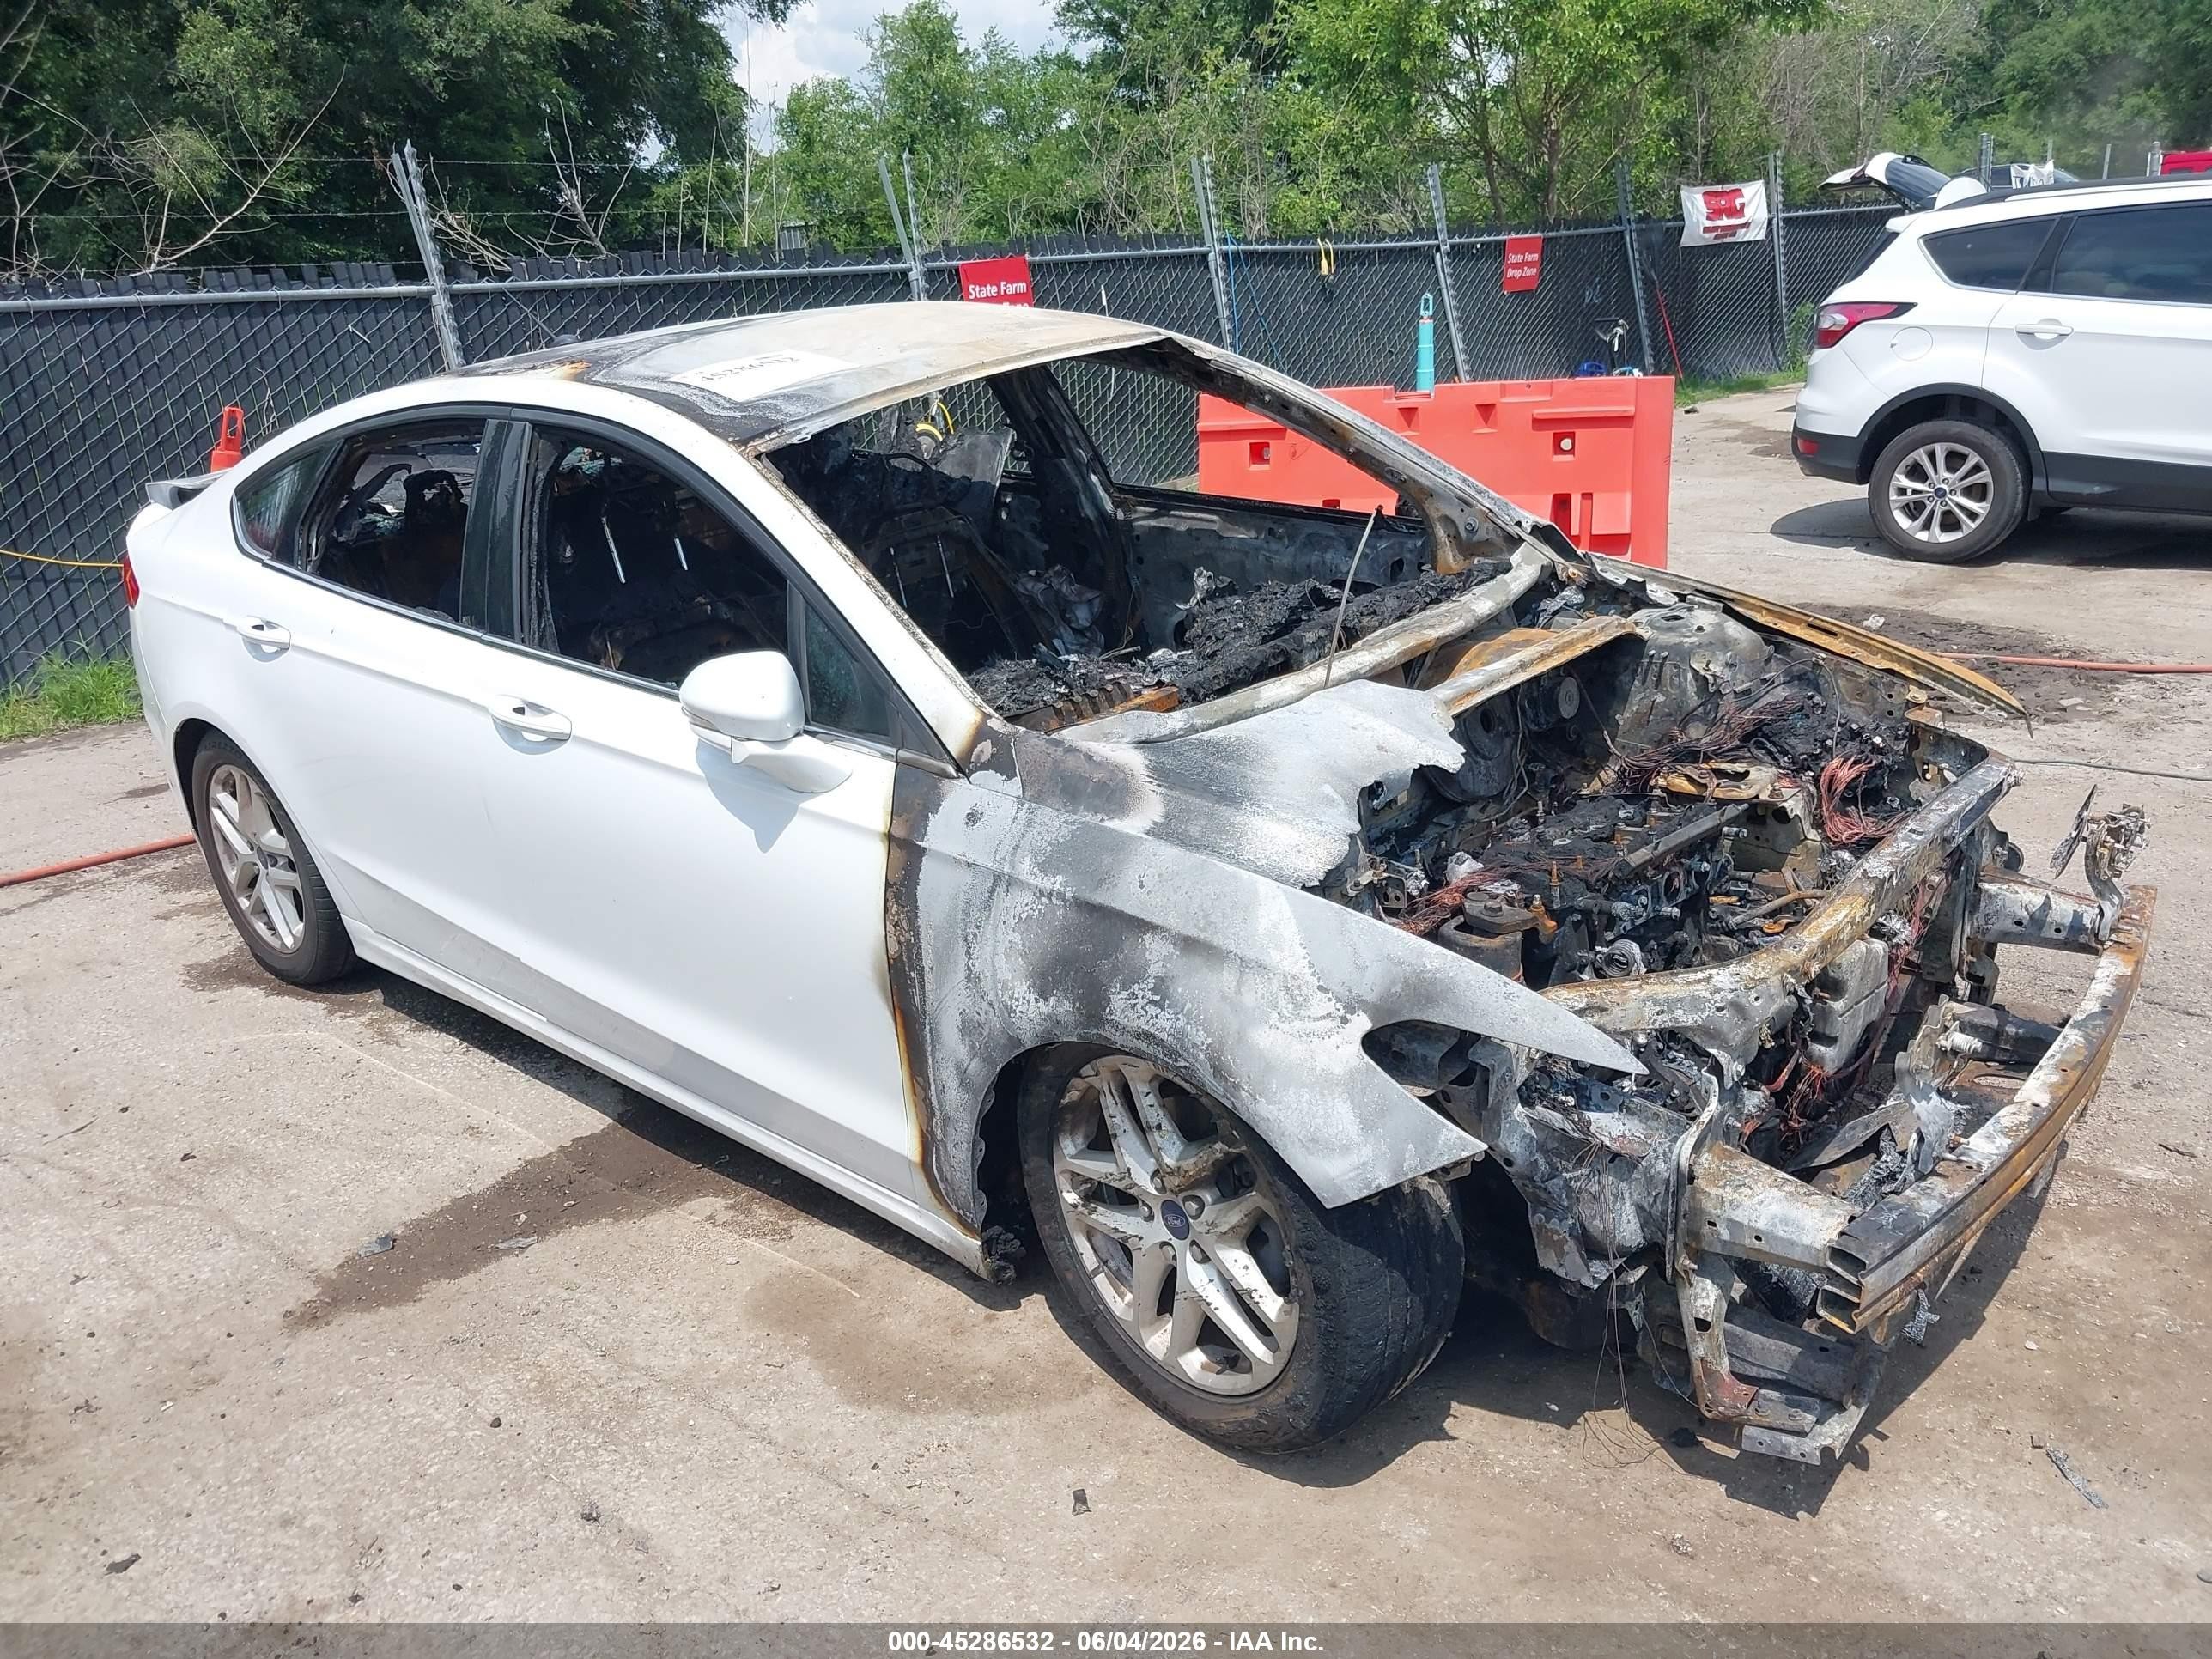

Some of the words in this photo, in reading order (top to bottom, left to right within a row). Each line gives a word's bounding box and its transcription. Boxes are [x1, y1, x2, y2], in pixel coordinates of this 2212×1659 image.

[1507, 252, 1524, 264] State
[1524, 252, 1539, 262] Farm
[1506, 267, 1522, 279] Drop
[1522, 266, 1537, 276] Zone
[968, 283, 998, 300] State
[1000, 281, 1027, 295] Farm
